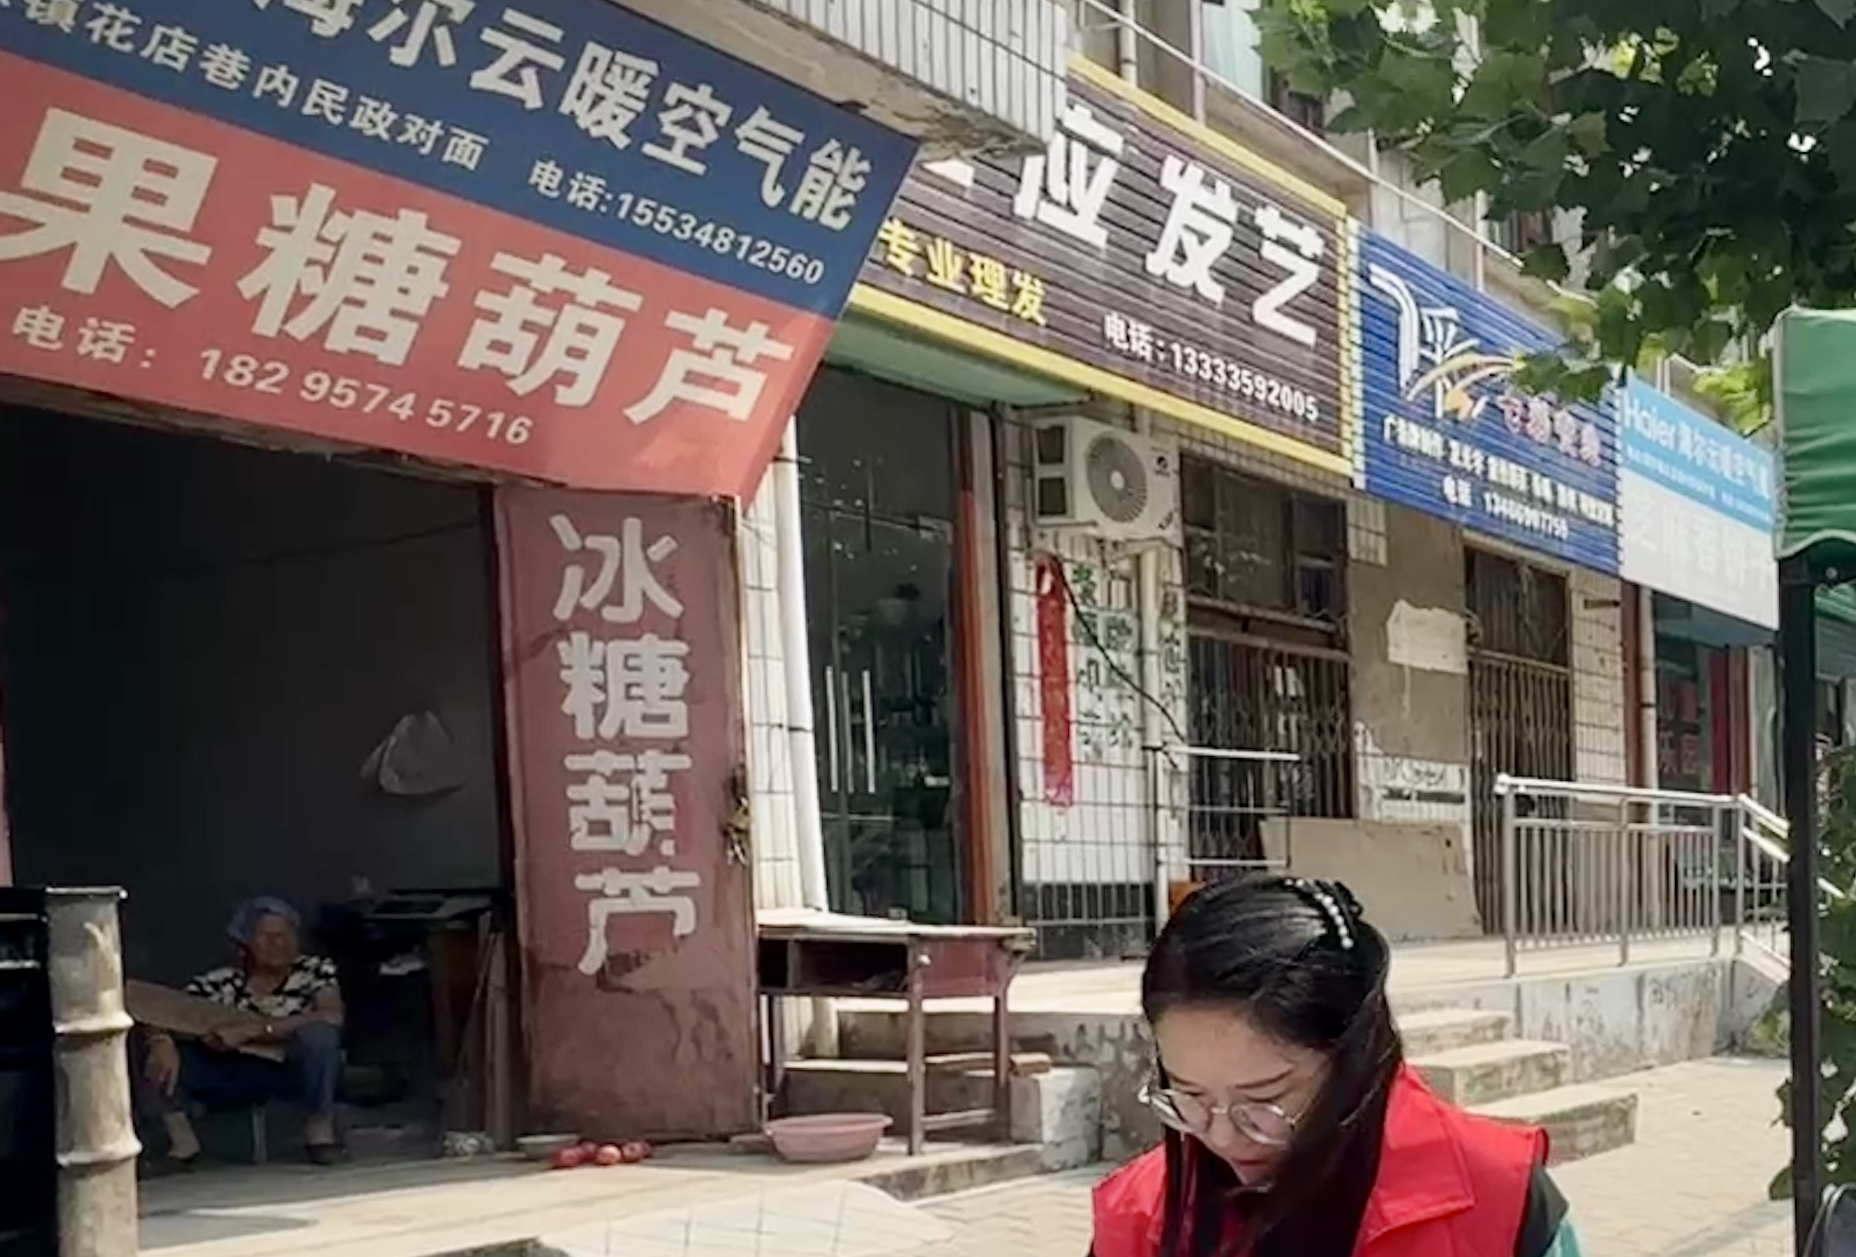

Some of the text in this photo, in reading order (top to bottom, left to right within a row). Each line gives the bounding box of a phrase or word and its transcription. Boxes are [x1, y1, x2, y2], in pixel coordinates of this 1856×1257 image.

[878, 218, 1047, 326] 专业理发
[549, 514, 701, 976] 冰糖葫芦
